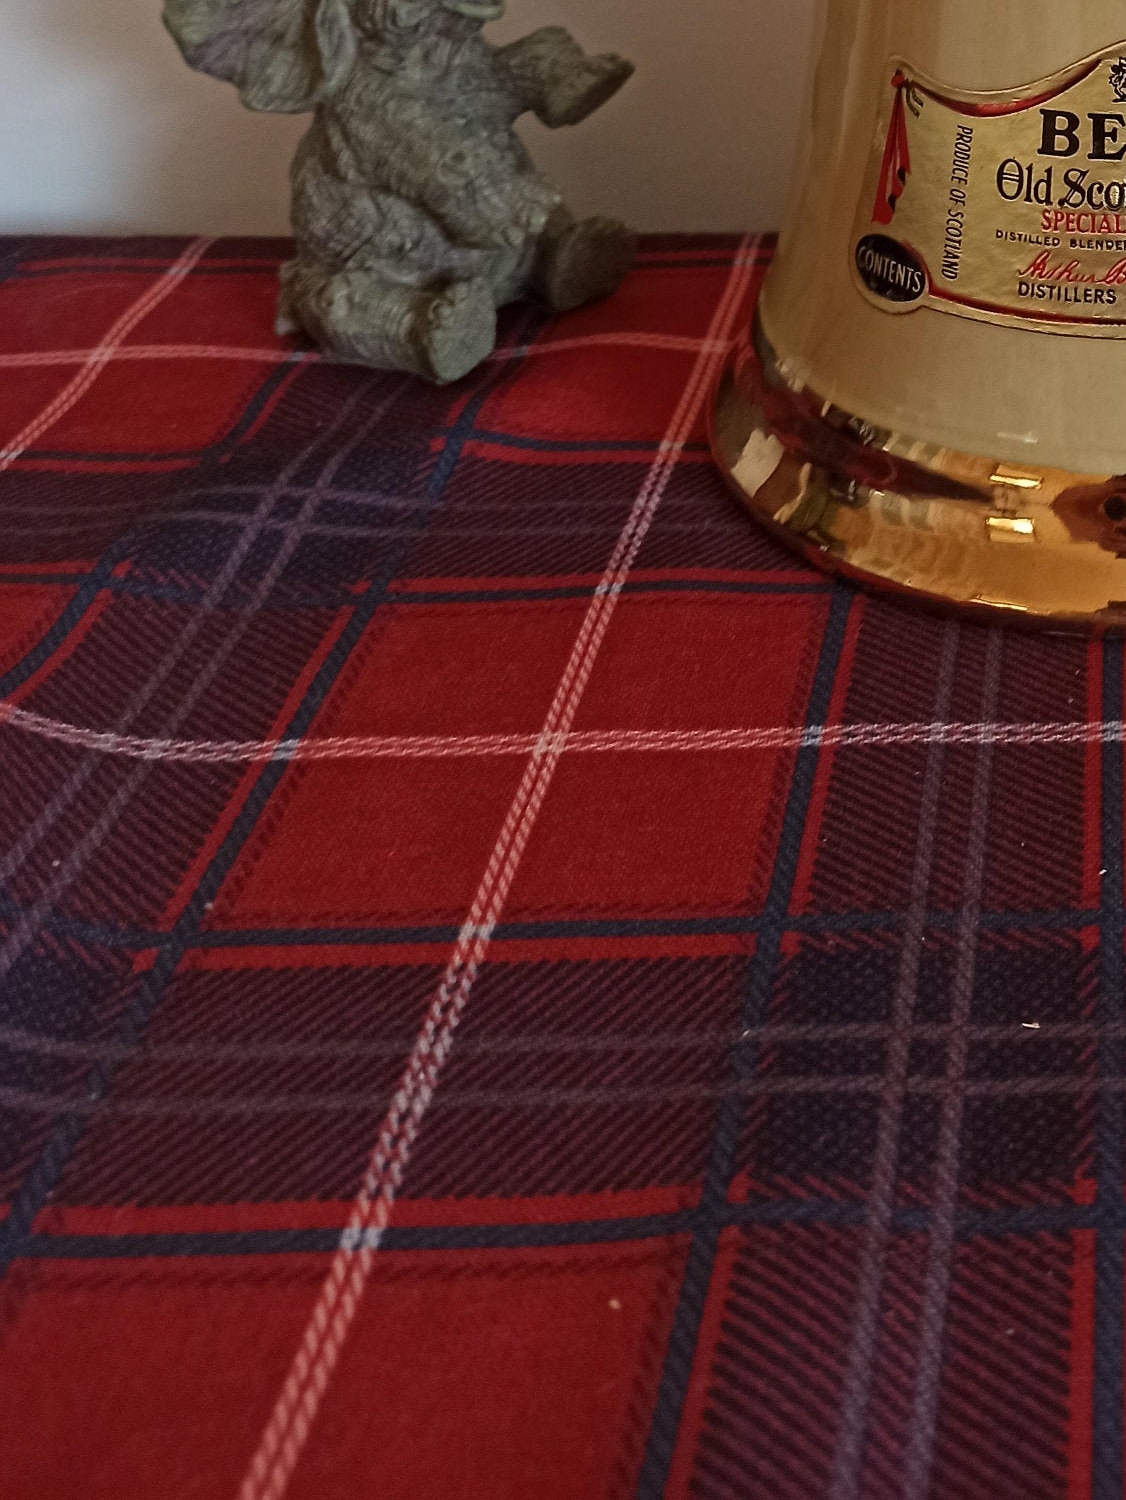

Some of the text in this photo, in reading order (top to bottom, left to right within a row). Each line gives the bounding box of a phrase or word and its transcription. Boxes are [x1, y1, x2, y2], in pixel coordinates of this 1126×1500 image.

[996, 156, 1052, 205] Old
[941, 124, 973, 280] PRODUCE OF SCOTLAND
[995, 229, 1060, 247] DISTILLED
[858, 246, 923, 294] CONTENTS
[1017, 249, 1101, 283] Arthur
[1018, 280, 1117, 305] DISTILLERS
